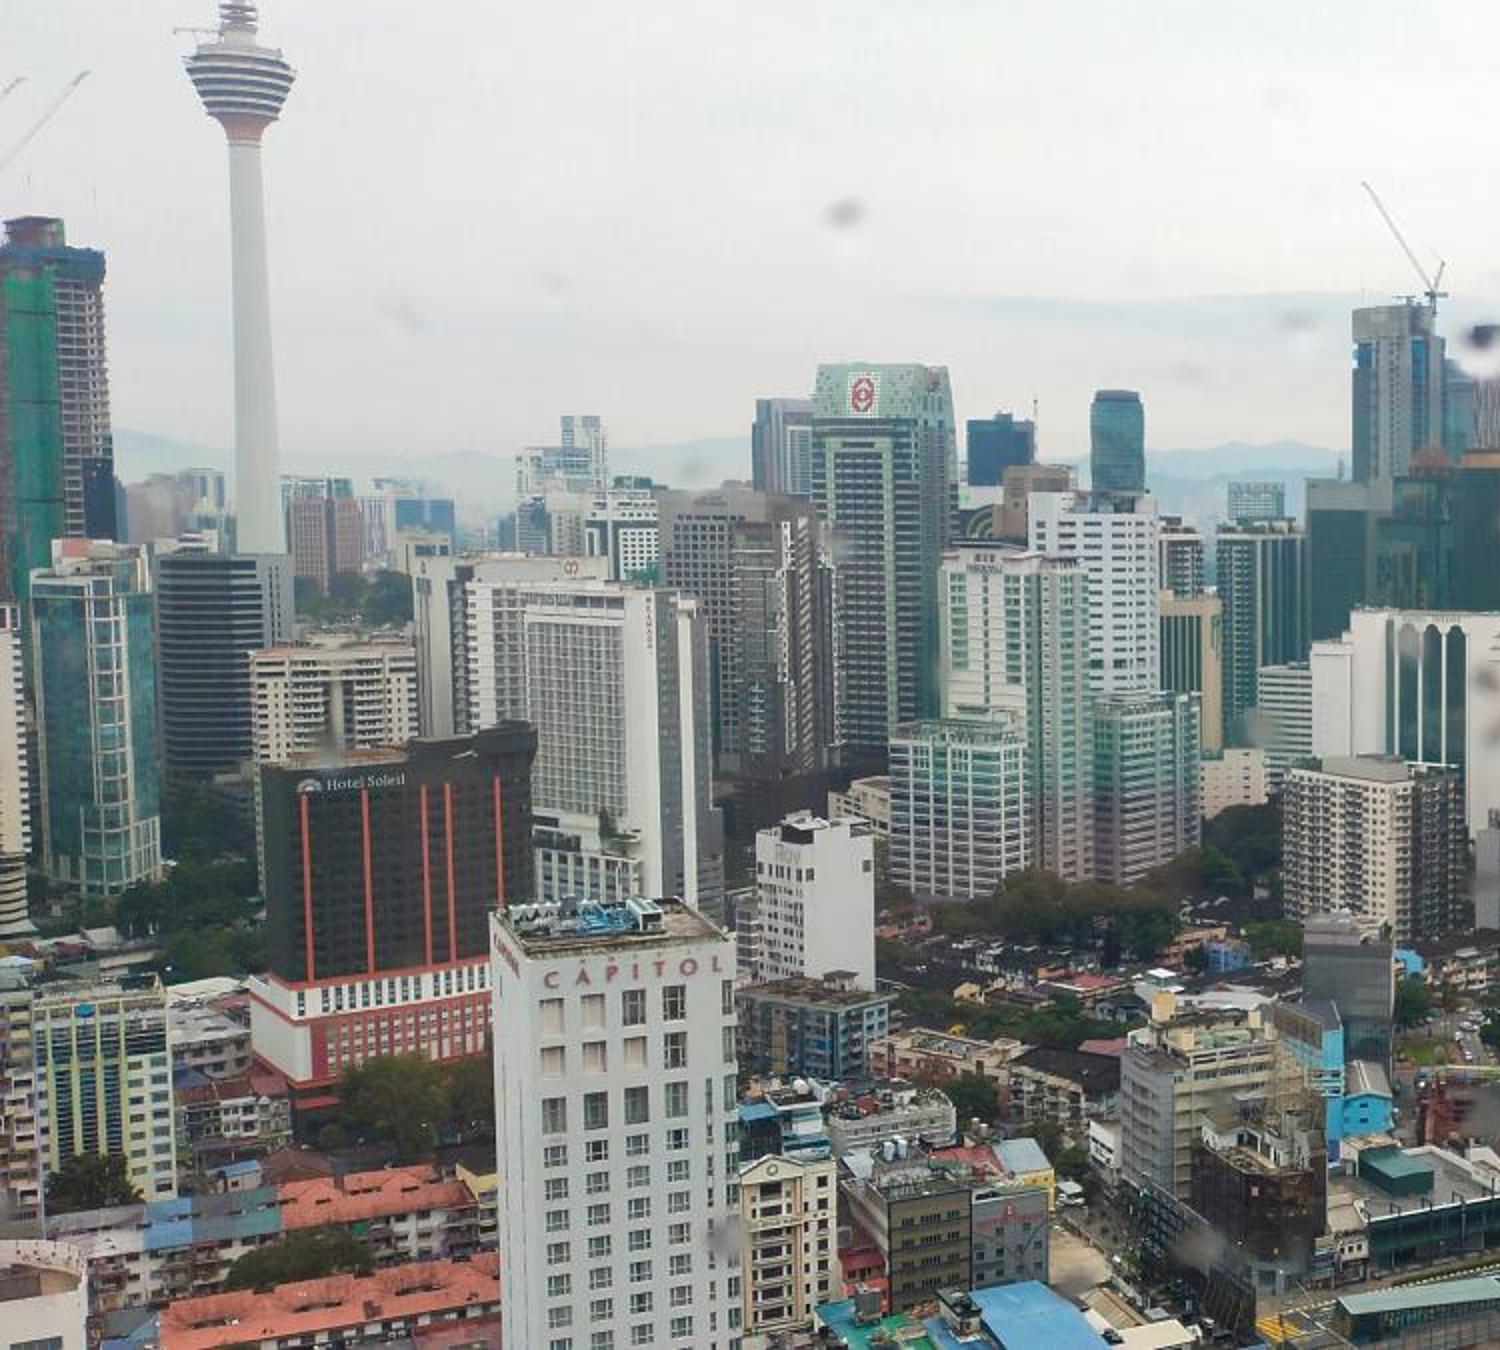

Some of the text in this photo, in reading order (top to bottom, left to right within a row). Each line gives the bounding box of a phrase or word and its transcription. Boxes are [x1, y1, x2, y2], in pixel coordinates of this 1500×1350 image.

[327, 772, 406, 791] Hotel Soleil
[543, 955, 723, 990] CAPITOL
